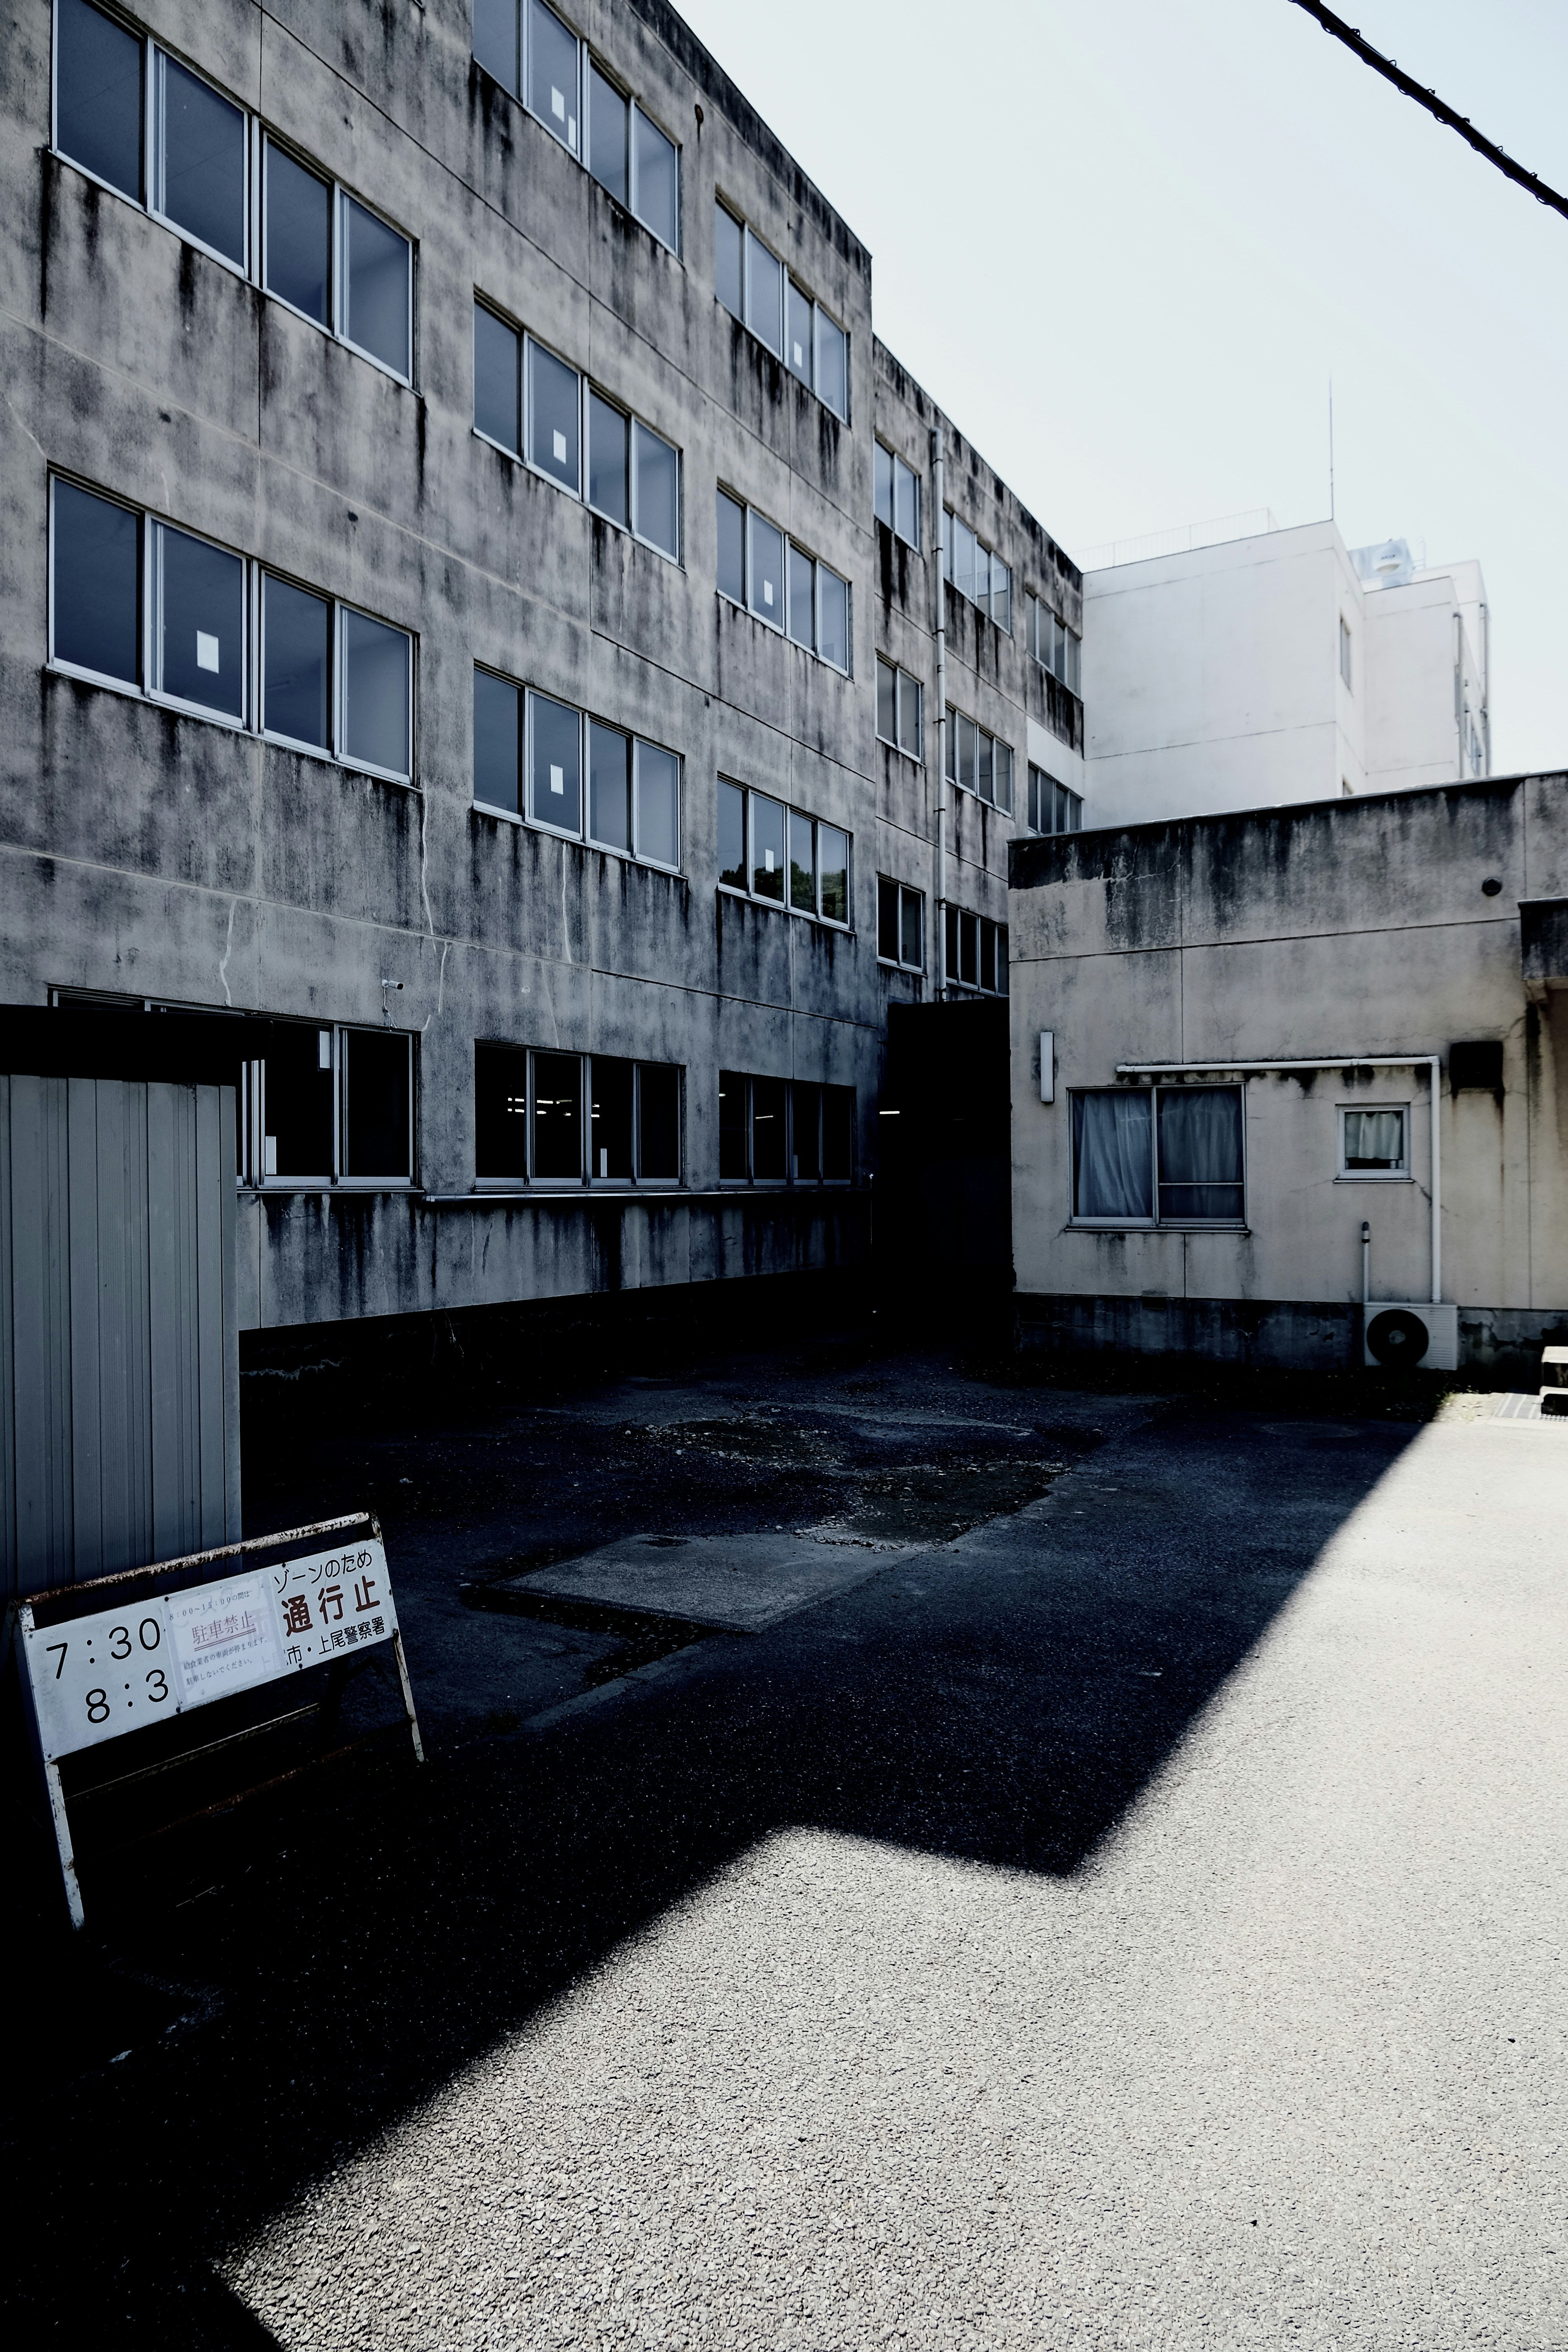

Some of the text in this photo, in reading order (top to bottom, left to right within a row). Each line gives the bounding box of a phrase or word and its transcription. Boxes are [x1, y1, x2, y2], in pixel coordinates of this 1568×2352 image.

[274, 1549, 372, 1593] ゾーンのため
[192, 1611, 254, 1644] 駐車禁止
[281, 1575, 380, 1637] 通行止
[46, 1618, 160, 1679] 7:30
[283, 1616, 385, 1665] 市・上尾警察署
[85, 1669, 169, 1724] 8:3
